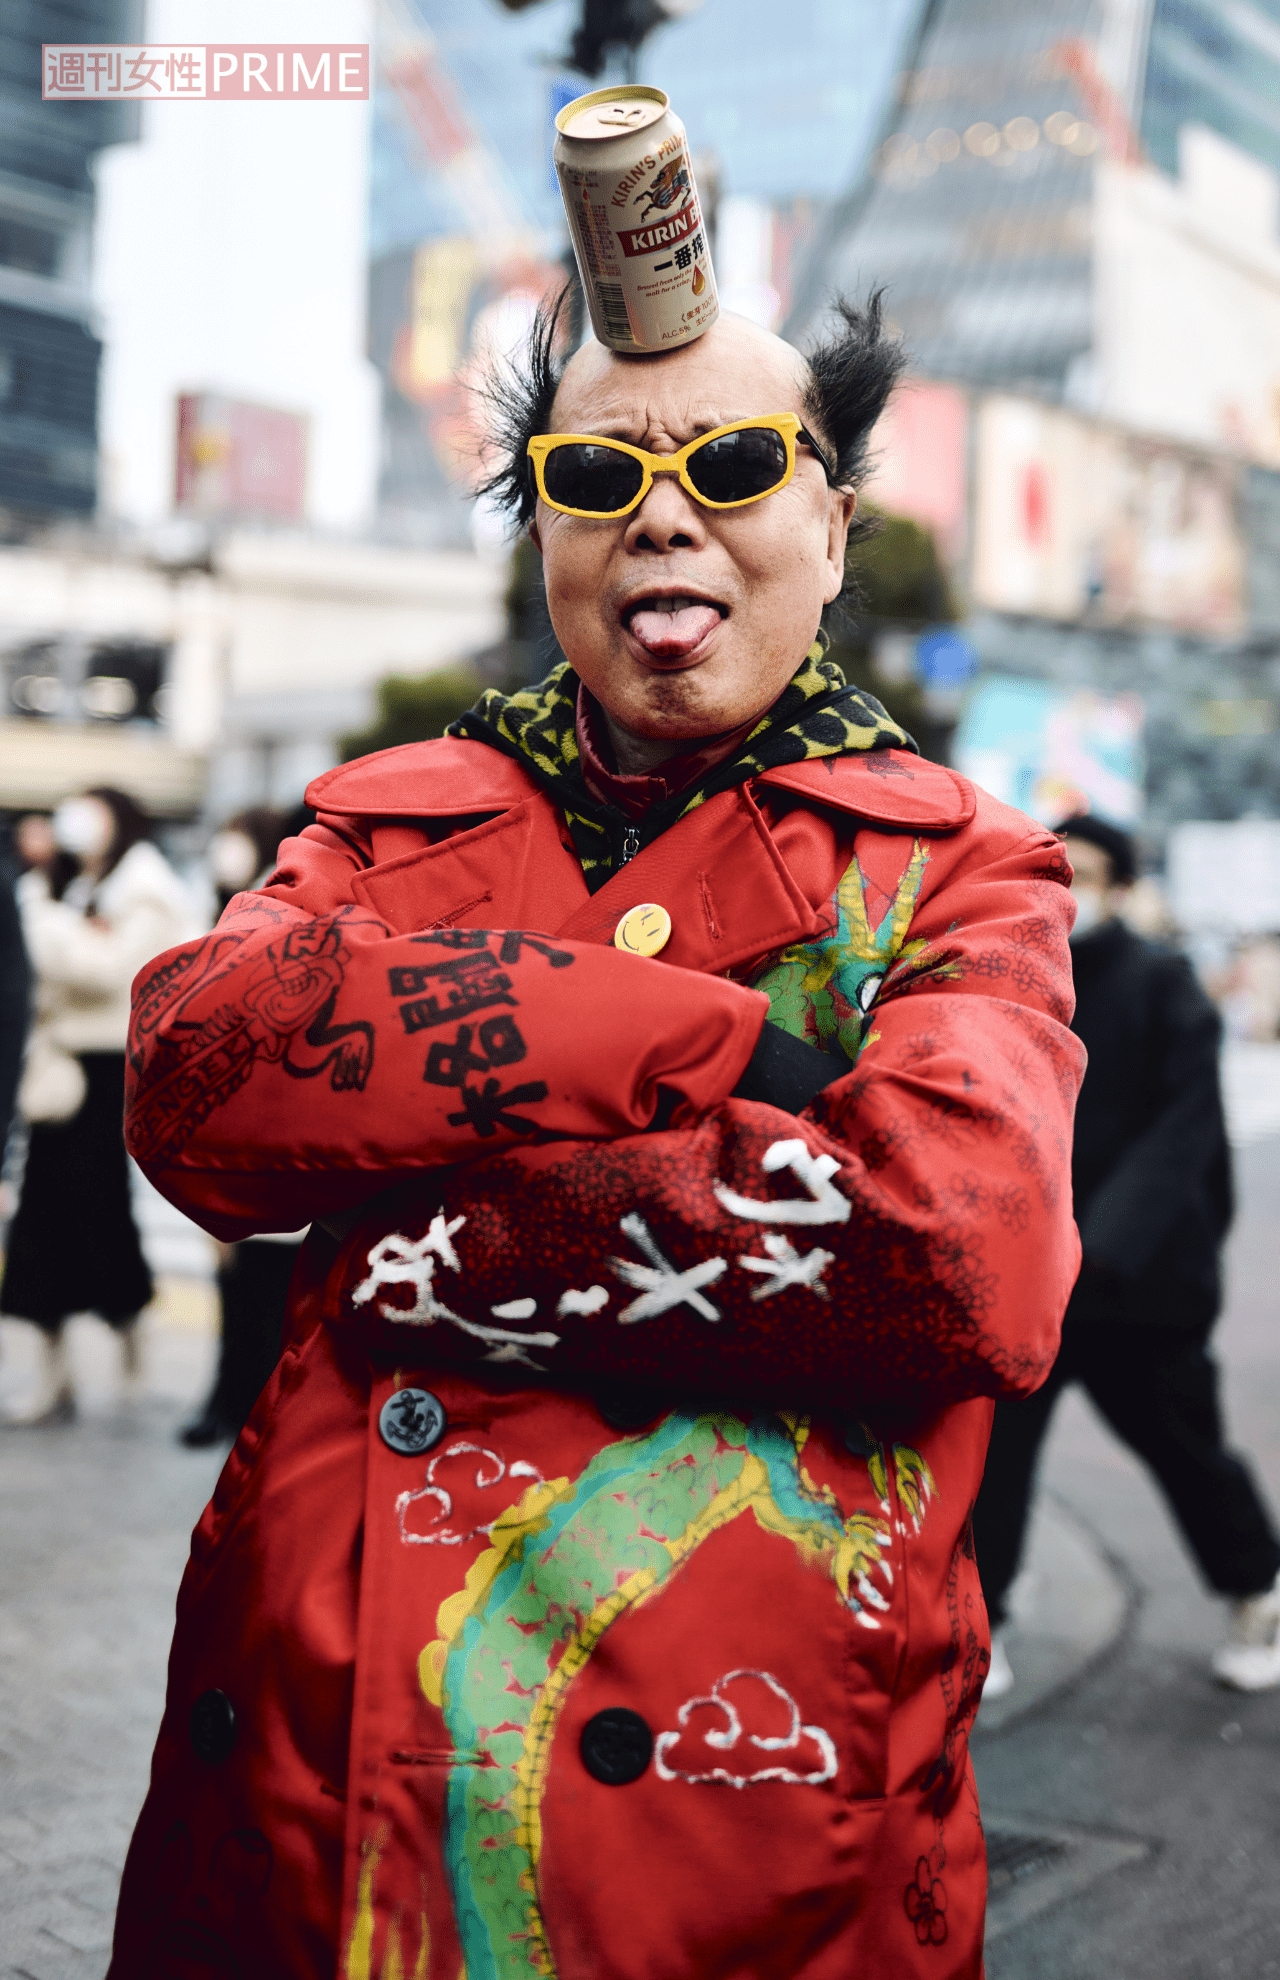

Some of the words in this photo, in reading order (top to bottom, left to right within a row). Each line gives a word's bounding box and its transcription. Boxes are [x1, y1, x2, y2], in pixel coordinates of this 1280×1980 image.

[611, 155, 657, 208] KIRIN'S
[630, 213, 689, 251] KIRIN
[689, 204, 700, 226] B
[661, 286, 671, 294] for
